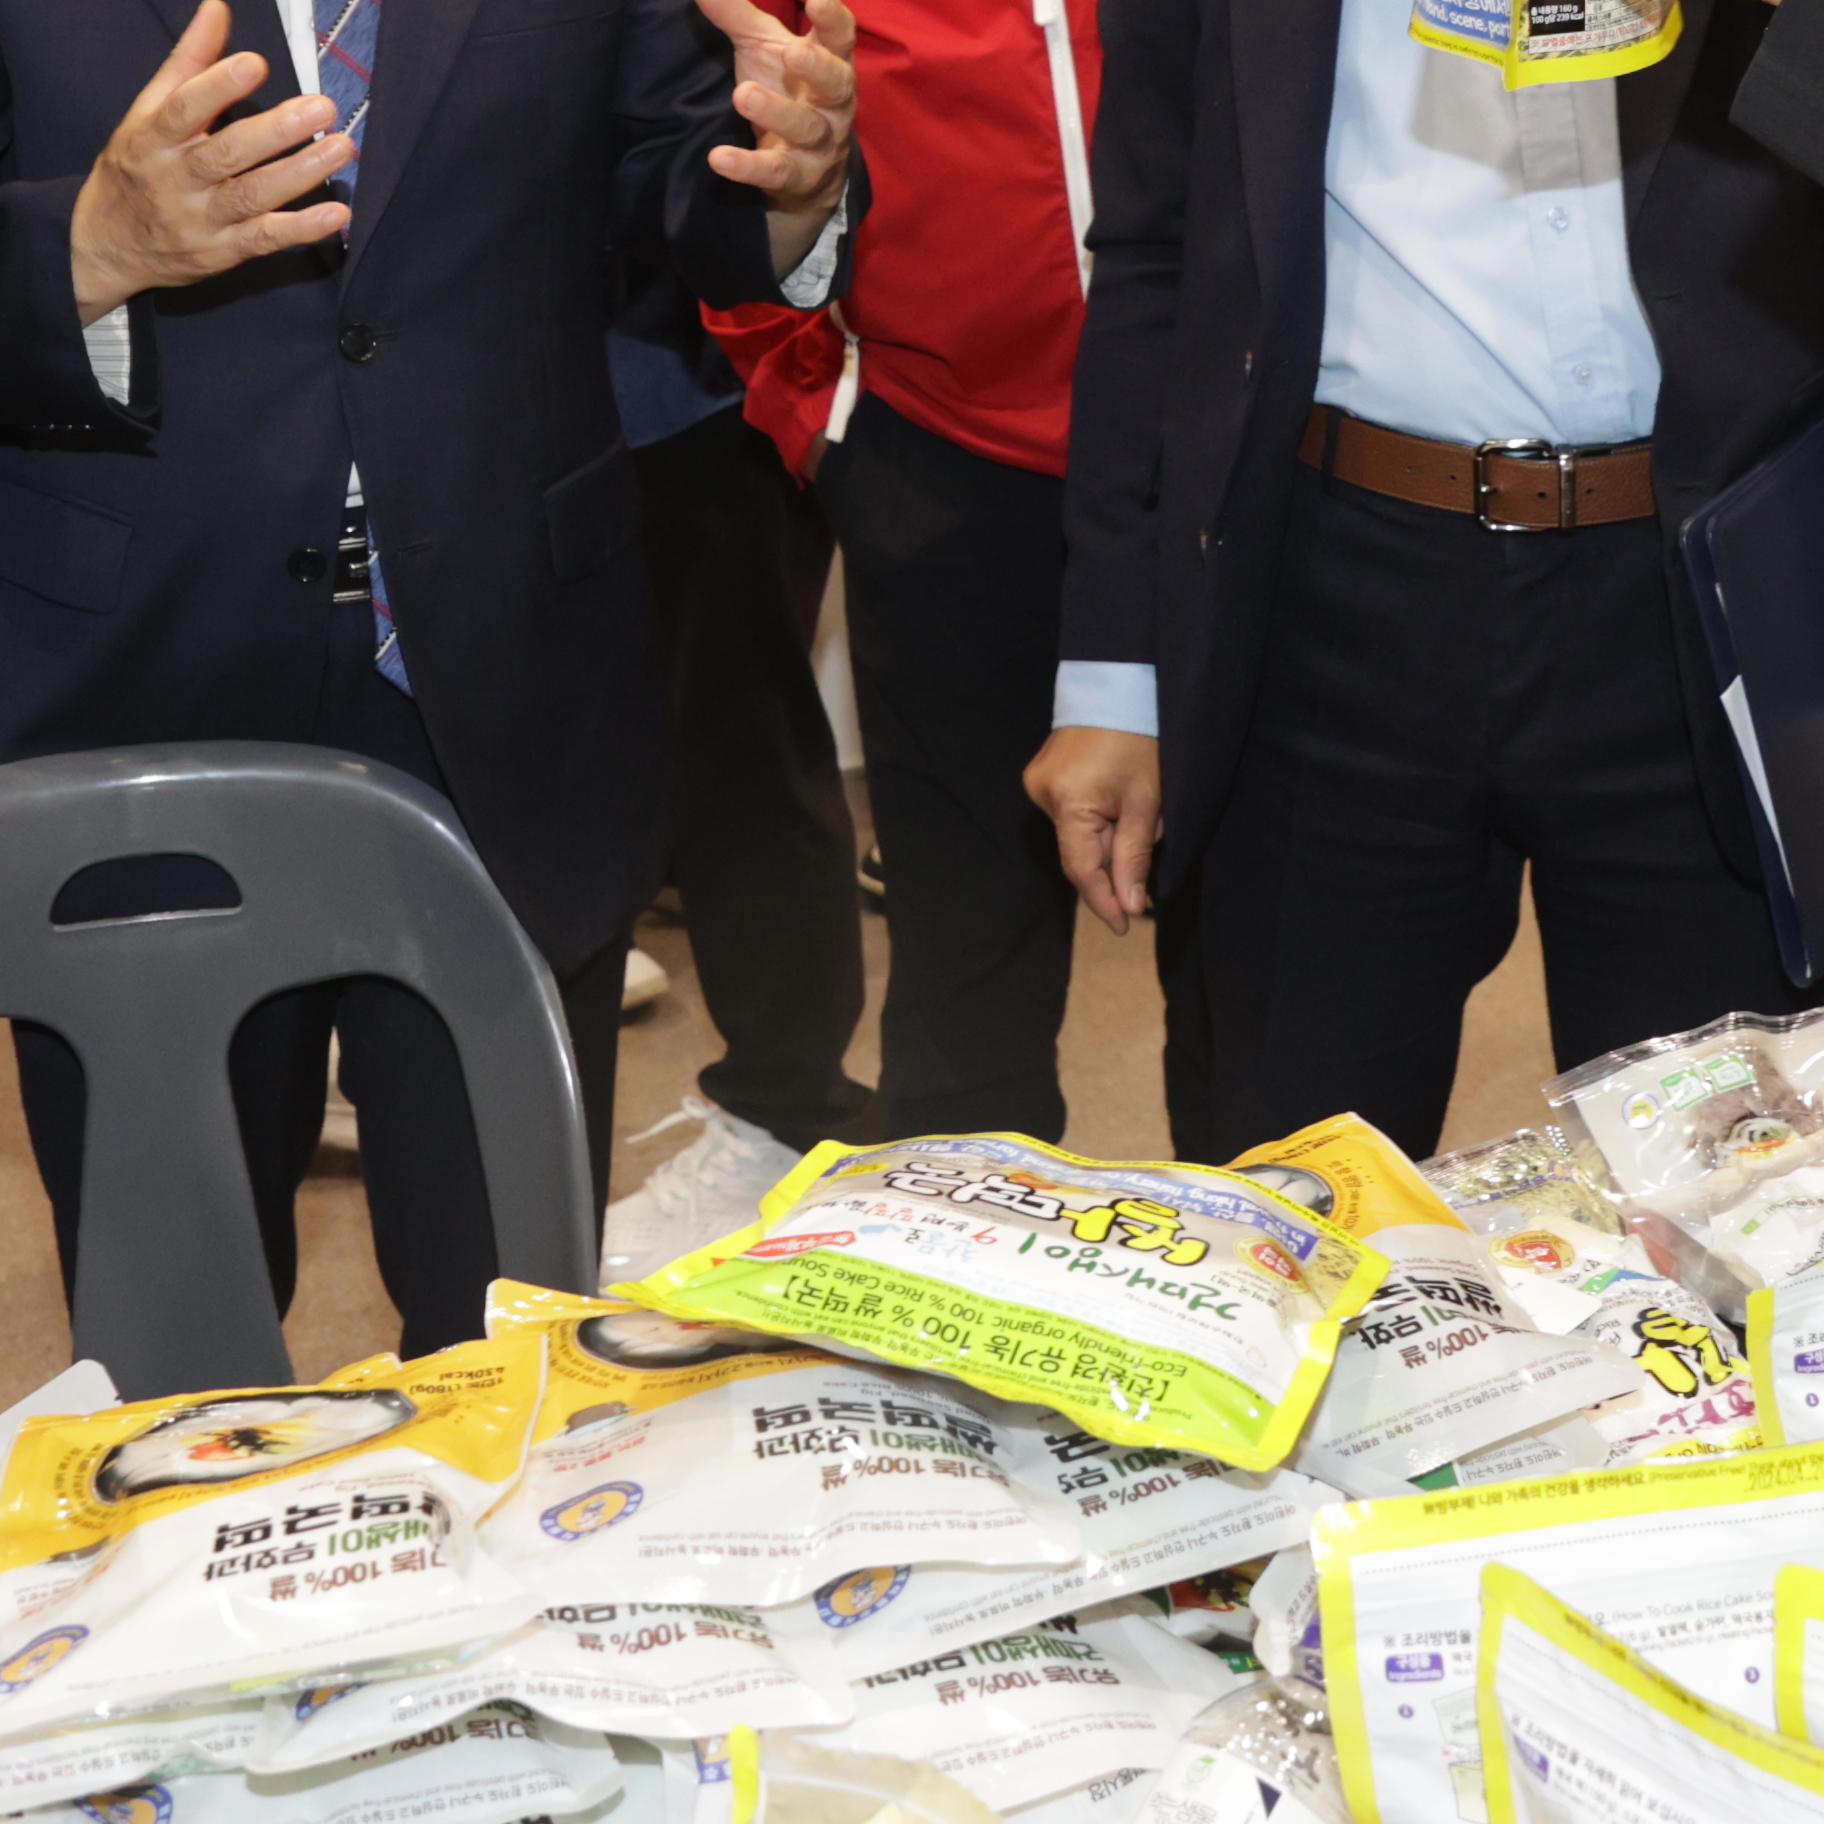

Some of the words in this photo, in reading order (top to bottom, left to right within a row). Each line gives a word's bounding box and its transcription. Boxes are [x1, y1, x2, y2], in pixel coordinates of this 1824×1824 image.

[833, 1268, 881, 1290] Cake
[882, 1280, 925, 1303] Rice
[929, 1292, 945, 1311] %
[854, 1292, 883, 1320] 쌀
[892, 1305, 915, 1328] %
[949, 1302, 985, 1325] 100
[921, 1316, 971, 1350] 100
[991, 1316, 1065, 1340] organic
[1349, 1313, 1423, 1351] 무화
[1425, 1324, 1489, 1360] 100%
[982, 1334, 1067, 1374] 유기농
[1068, 1331, 1188, 1378] Eco-friendly
[1397, 1345, 1427, 1369] 쌀
[1557, 1356, 1592, 1373] 어린이도
[1463, 1387, 1499, 1407] 안심하고
[1414, 1410, 1433, 1425] 있는
[1434, 1402, 1462, 1419] 드실수
[752, 1425, 860, 1459] 무화과
[1385, 1423, 1413, 1440] 무농약
[853, 1456, 922, 1479] 100%
[1495, 1456, 1523, 1472] 환자도
[1525, 1448, 1562, 1464] 어린이도
[821, 1464, 848, 1492] 쌀
[1465, 1465, 1494, 1480] 누구나
[1108, 1473, 1180, 1506] 100%
[1479, 1490, 1503, 1506] 나와
[1505, 1485, 1542, 1504] 가족의
[1544, 1480, 1580, 1498] 건강을
[1076, 1495, 1108, 1518] 쌀
[1254, 1503, 1296, 1522] 어린이도
[1220, 1517, 1252, 1536] 환자도
[1186, 1529, 1218, 1548] 누구나
[203, 1542, 318, 1582] 무화과
[391, 1547, 448, 1575] 기농
[1110, 1554, 1141, 1573] 드실수
[1142, 1541, 1185, 1563] 안심하고
[268, 1575, 299, 1603] 쌀
[304, 1560, 383, 1595] 100%
[1052, 1577, 1084, 1595] 무농약
[978, 1597, 1012, 1618] 비료로
[610, 1622, 686, 1655] 100%
[1400, 1629, 1472, 1648] 조리방법을
[966, 1668, 1041, 1697] 100%
[1041, 1665, 1120, 1686] 유기농
[933, 1678, 966, 1705] 쌀
[449, 1792, 485, 1809] 누구나
[488, 1785, 522, 1801] 환자도
[399, 1798, 447, 1818] 안심하고
